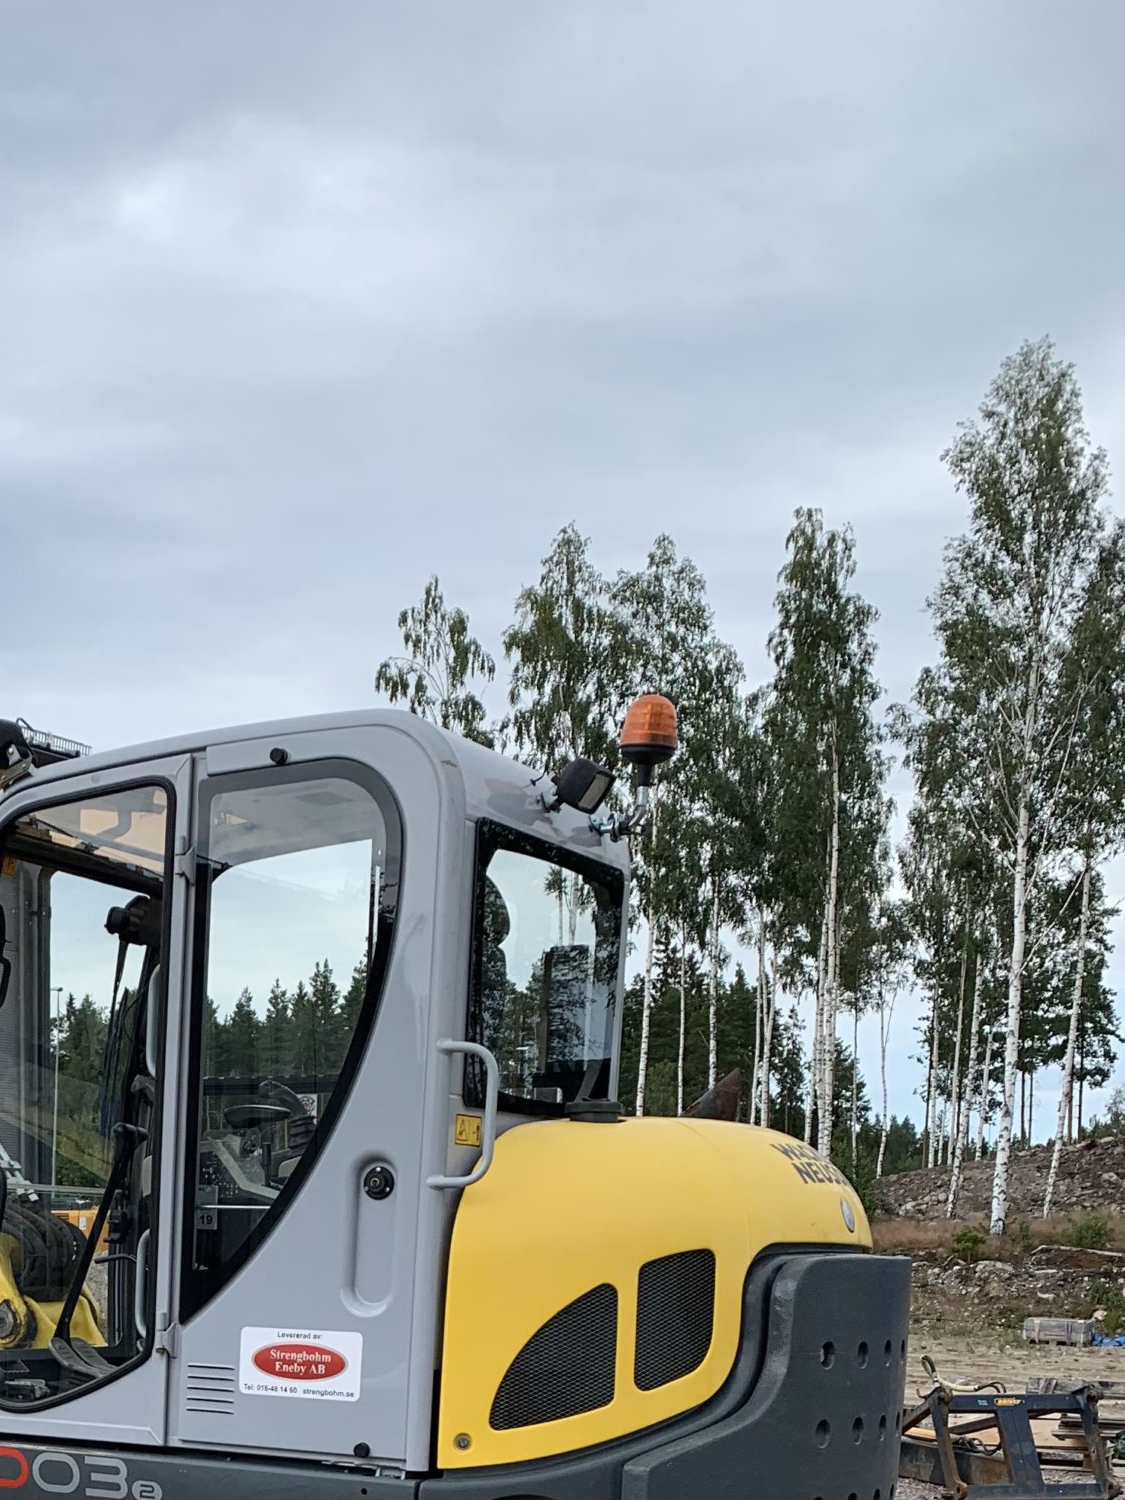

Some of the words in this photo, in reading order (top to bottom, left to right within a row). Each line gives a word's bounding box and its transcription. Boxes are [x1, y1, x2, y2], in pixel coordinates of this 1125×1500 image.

[199, 1215, 213, 1225] 19
[270, 1349, 331, 1364] Strengbohm
[275, 1362, 306, 1375] Eneby
[309, 1364, 326, 1374] AB
[303, 1388, 355, 1398] strengbohm.se
